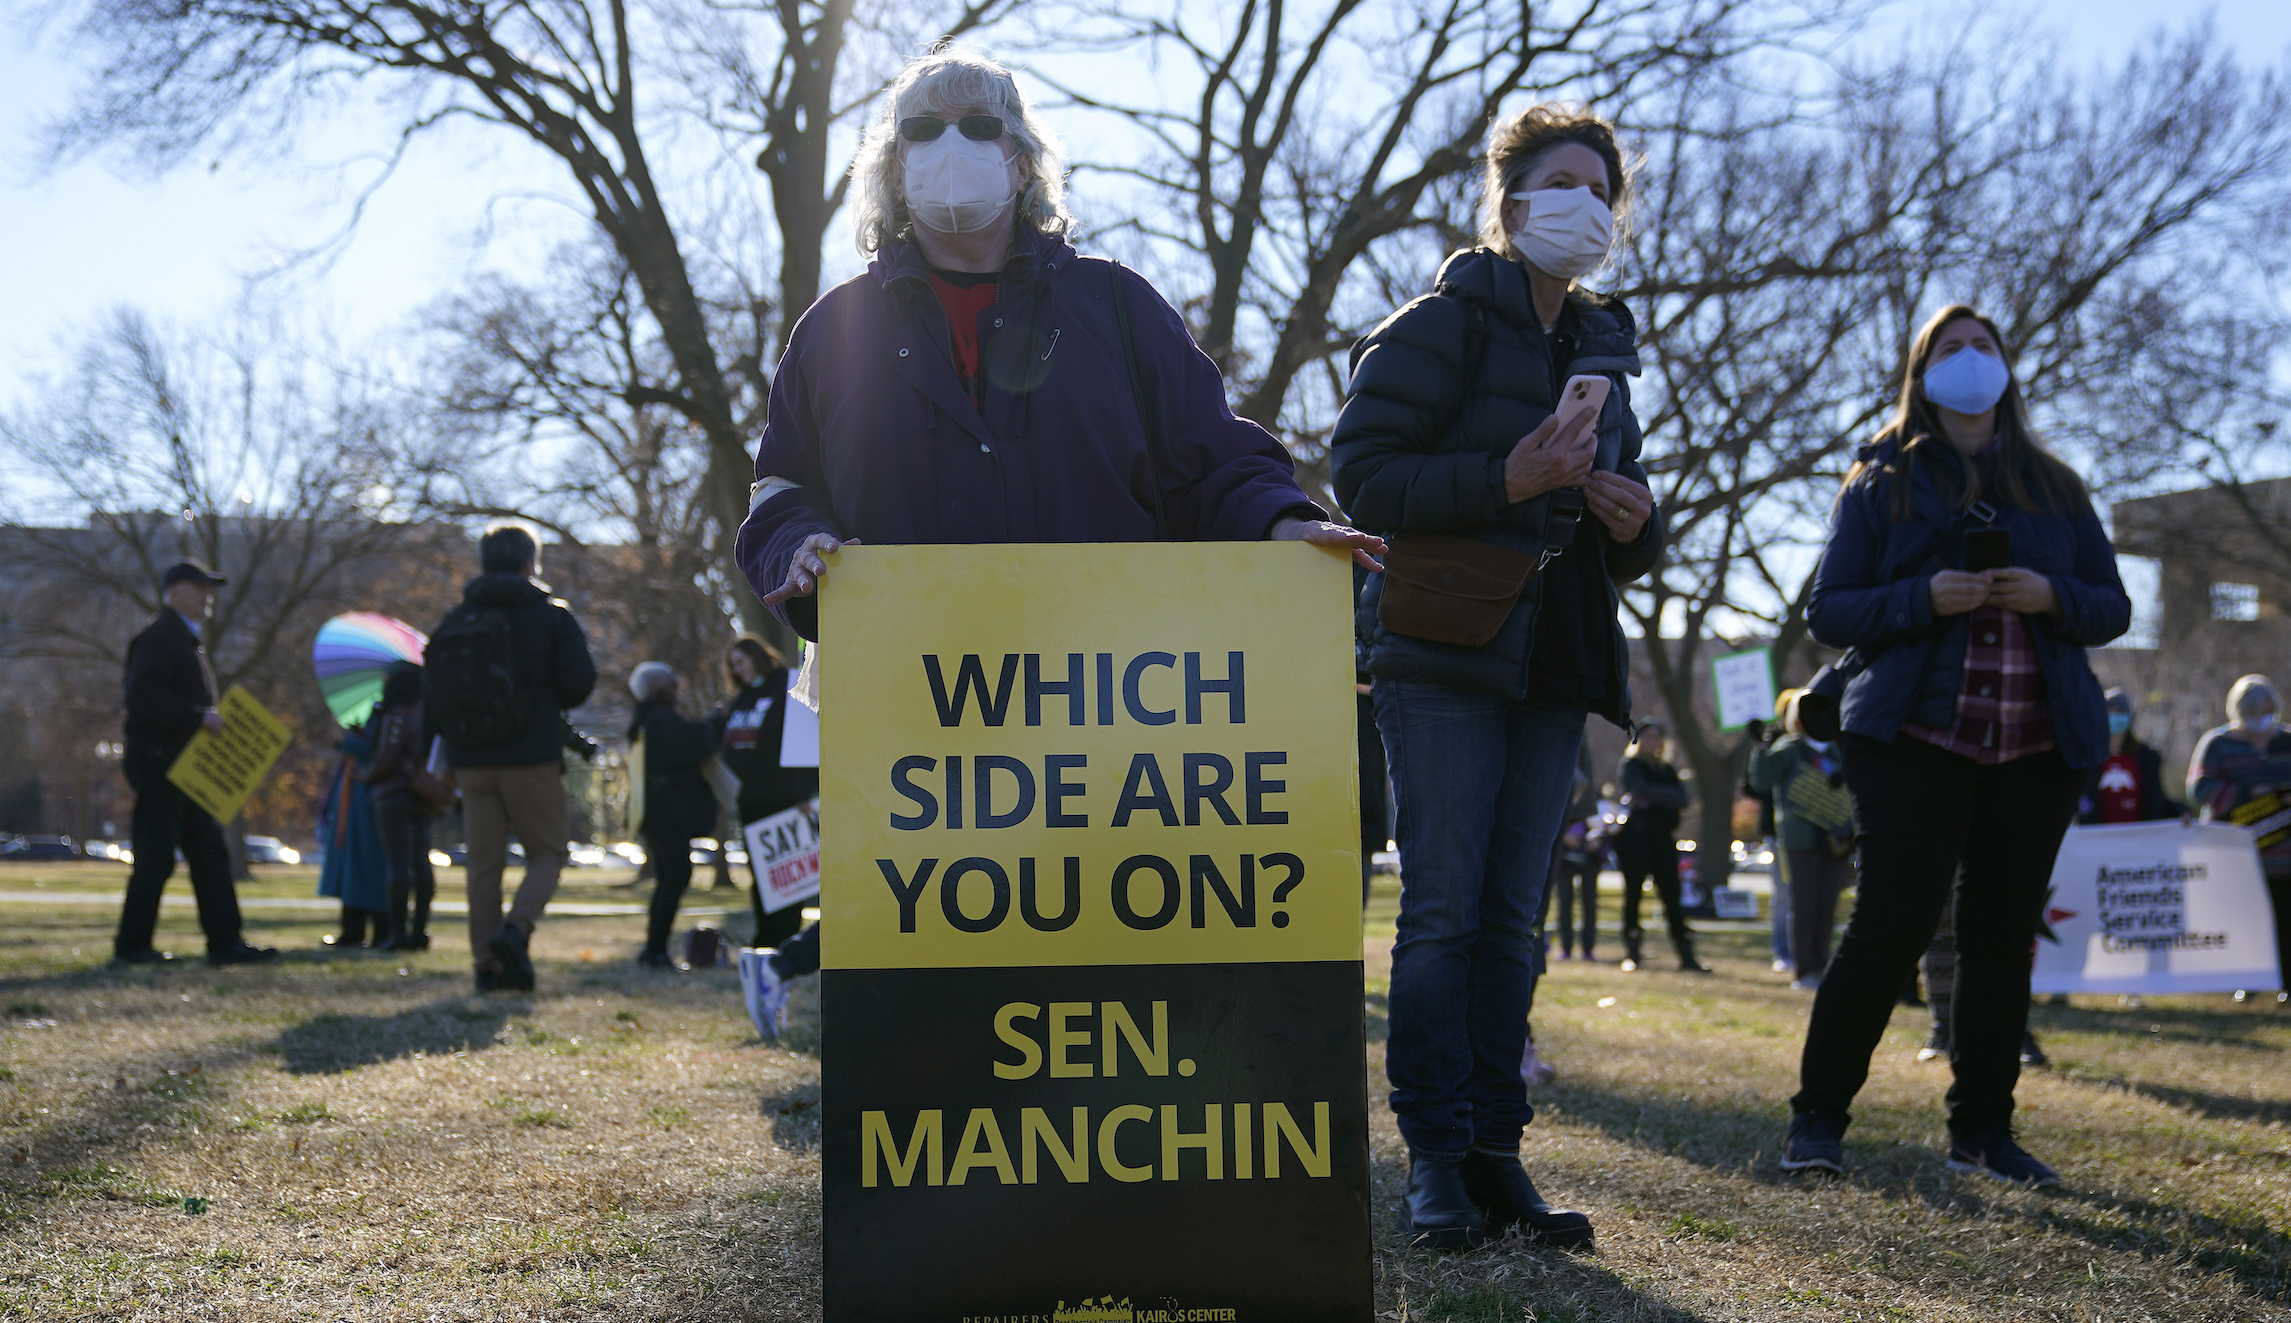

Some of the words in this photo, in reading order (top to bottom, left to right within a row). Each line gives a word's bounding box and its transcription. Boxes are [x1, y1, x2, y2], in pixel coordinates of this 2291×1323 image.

[921, 650, 1246, 727] WHICH
[889, 754, 1090, 831] SIDE
[1109, 751, 1290, 829] ARE
[758, 819, 800, 863] SAY
[874, 856, 1082, 934] YOU
[1110, 851, 1306, 931] ON?
[2097, 863, 2208, 884] American
[2098, 886, 2184, 908] Friends
[2100, 909, 2181, 933] Service
[2102, 931, 2229, 954] Committee
[992, 1001, 1197, 1080] SEN.
[860, 1101, 1332, 1188] MANCHIN
[1187, 1307, 1237, 1322] CENTER
